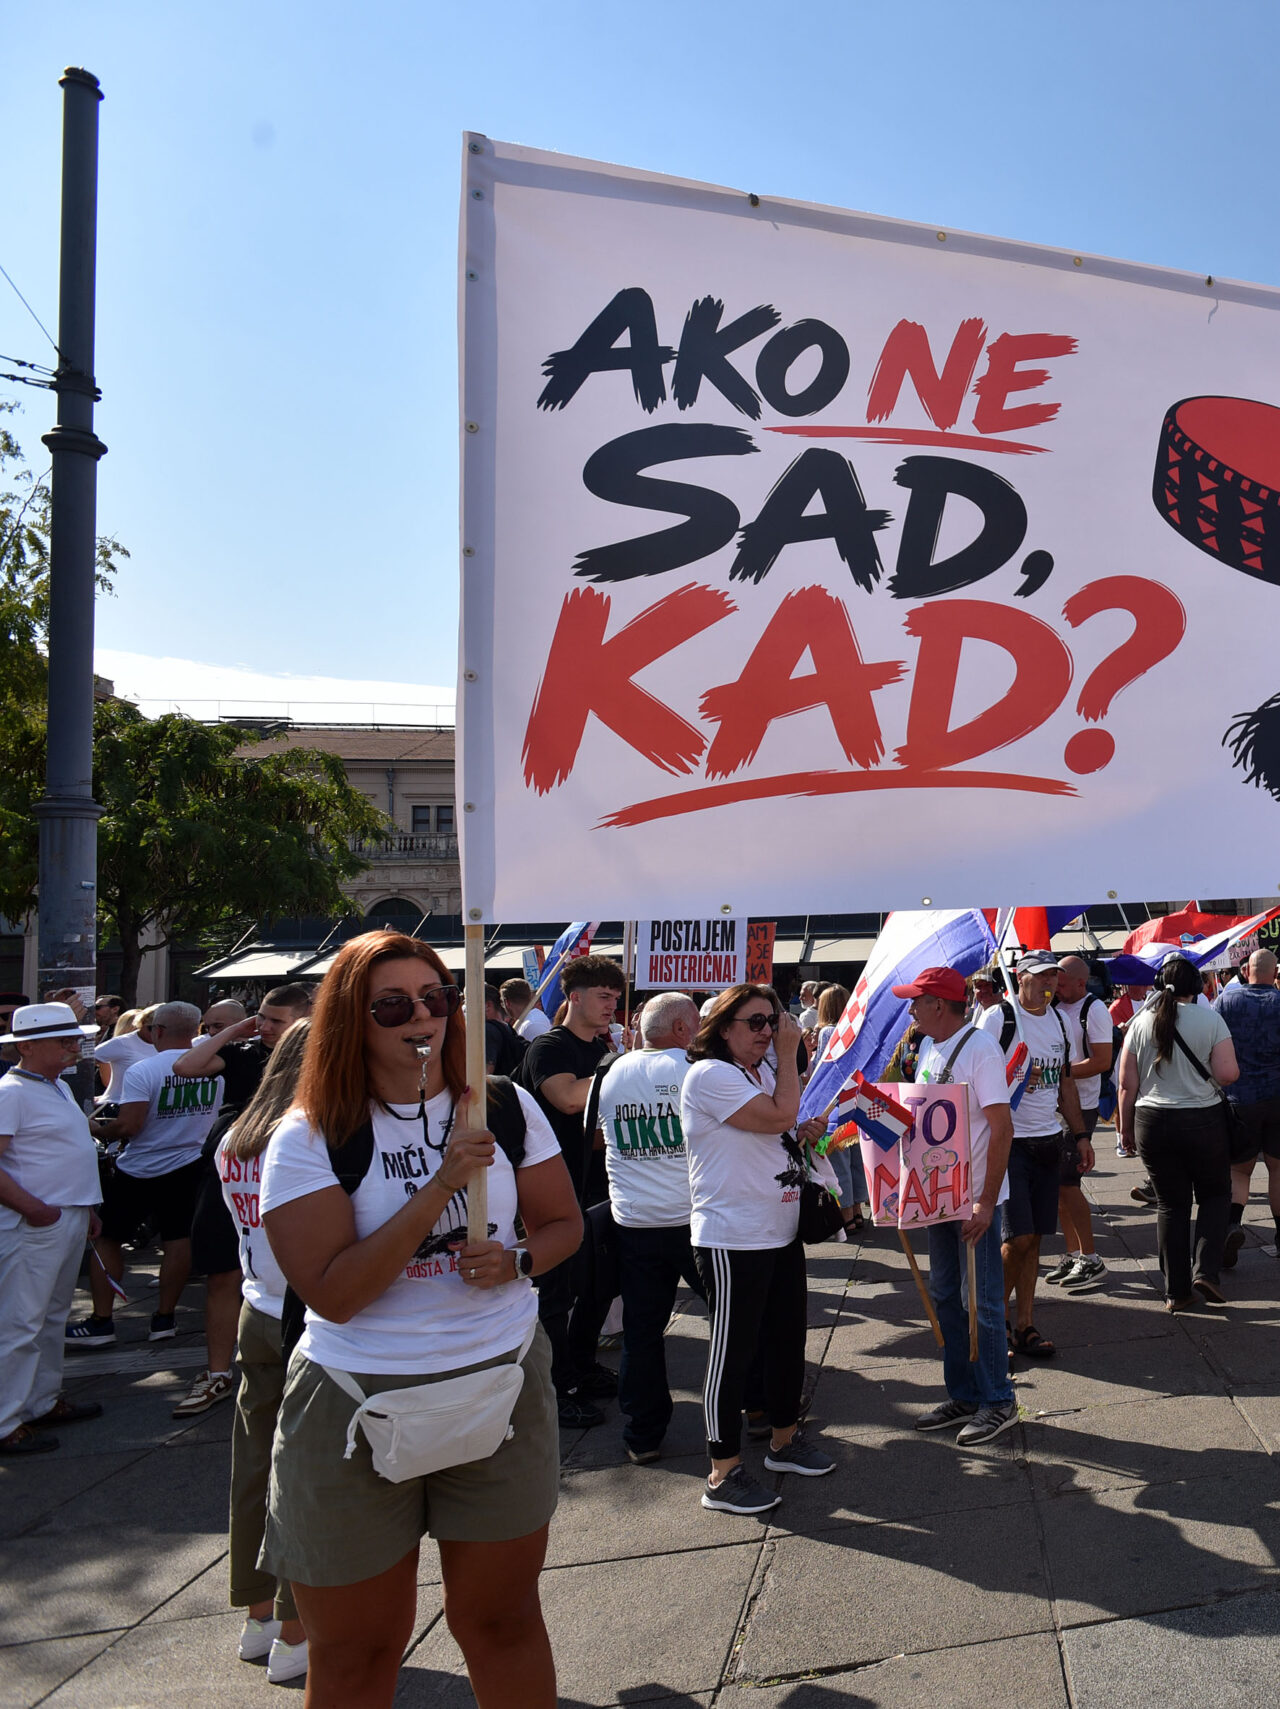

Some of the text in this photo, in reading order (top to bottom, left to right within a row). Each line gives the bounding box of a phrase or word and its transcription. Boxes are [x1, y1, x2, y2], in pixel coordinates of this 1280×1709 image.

[537, 287, 1080, 434] AKO NE
[572, 422, 1055, 600] SAD,
[521, 574, 1187, 797] KAD?
[650, 920, 736, 952] POSTAJEM
[649, 952, 737, 983] HISTERIČNA!
[157, 1081, 218, 1112] LIKU
[657, 1102, 676, 1120] ZA
[613, 1114, 684, 1151] LIKU
[381, 1143, 430, 1179] MIČI
[406, 1260, 443, 1278] DOSTA
